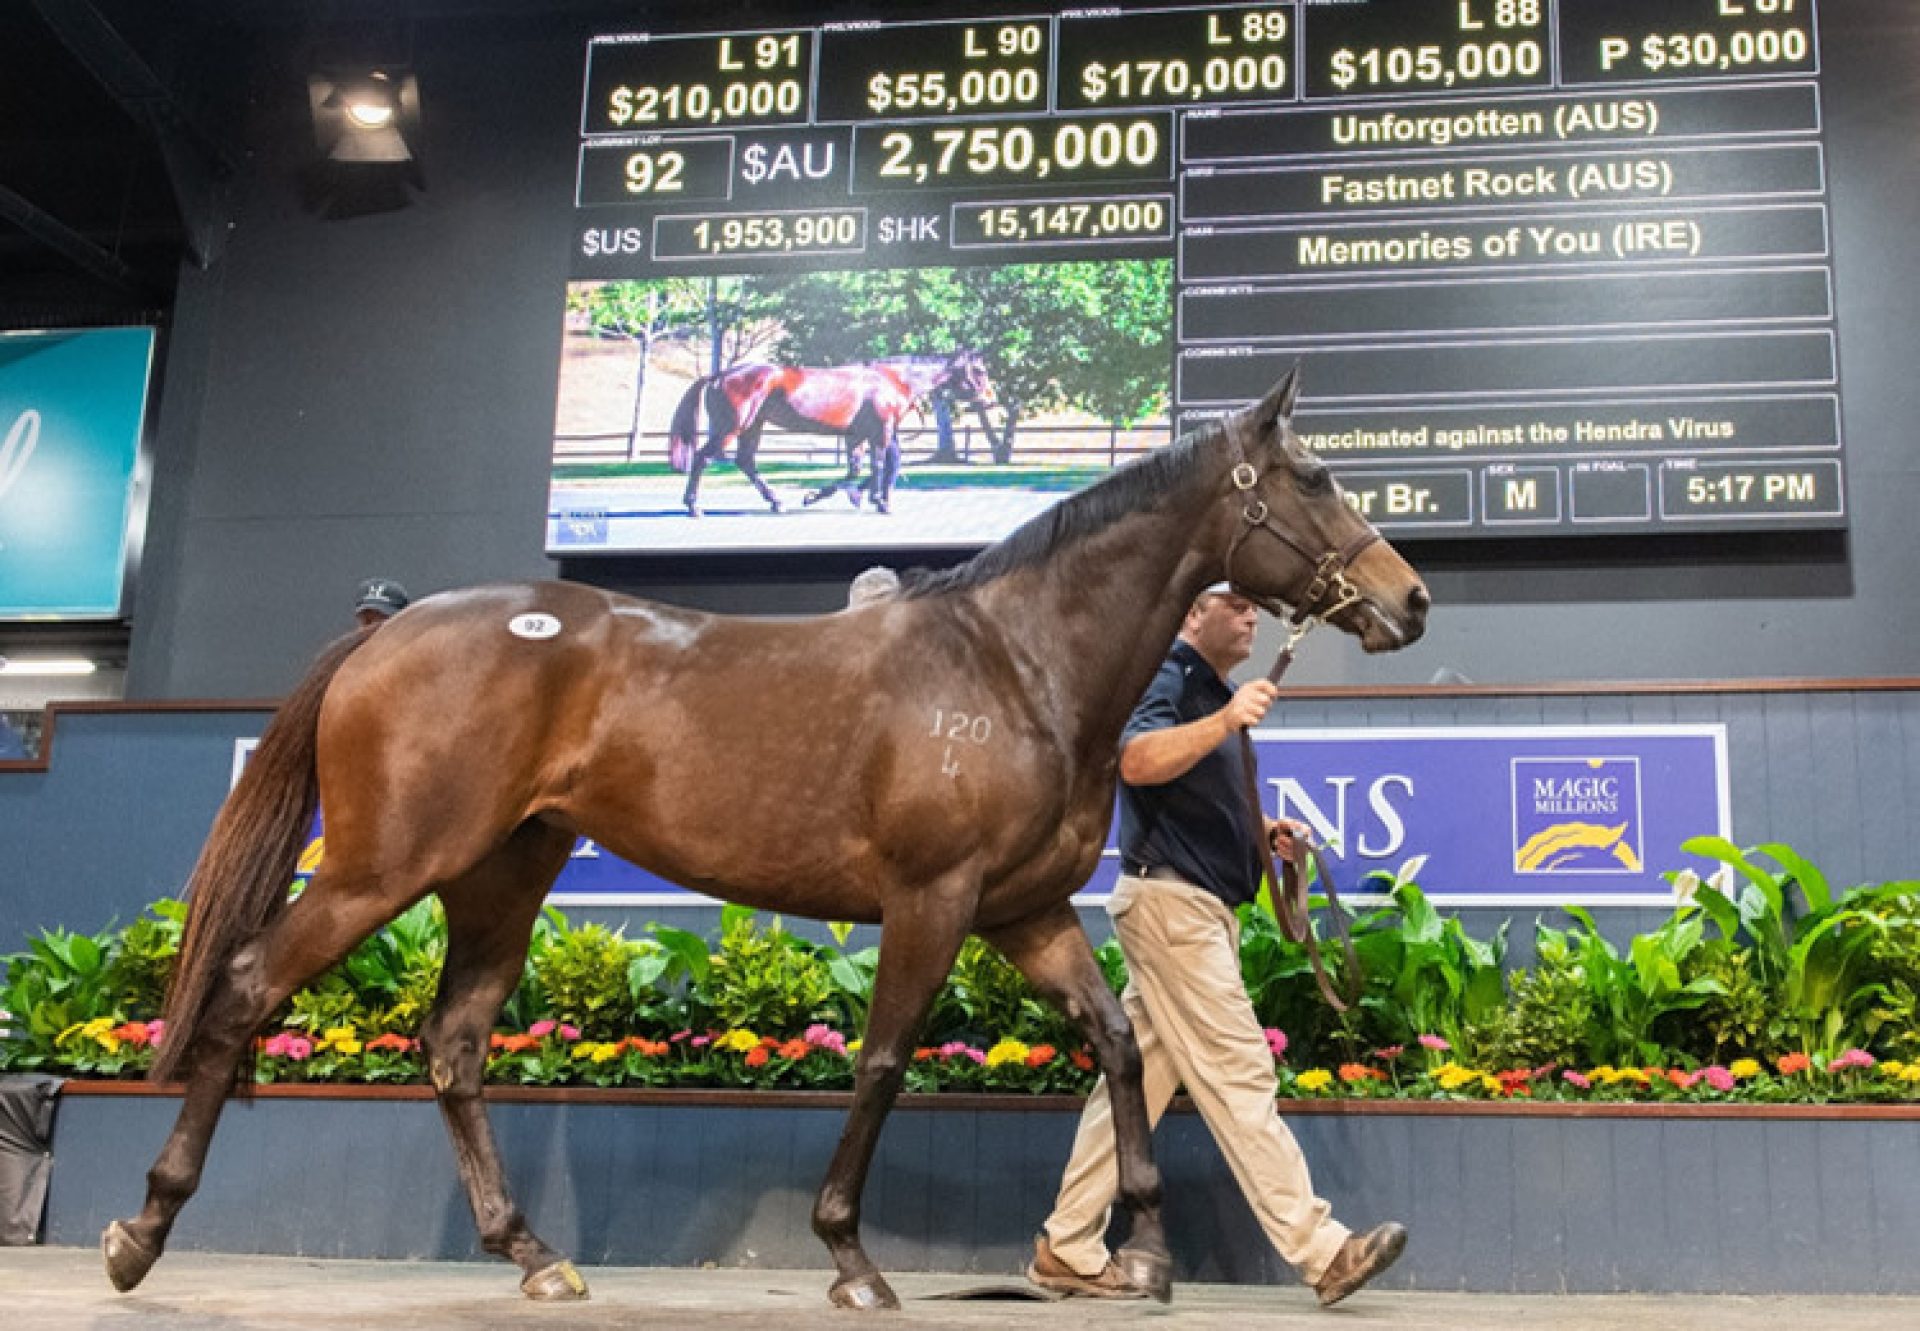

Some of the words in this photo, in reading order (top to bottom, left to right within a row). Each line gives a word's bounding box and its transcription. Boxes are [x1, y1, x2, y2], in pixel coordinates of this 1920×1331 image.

[1208, 15, 1232, 44] L
[1241, 12, 1286, 42] 89
[1459, 0, 1484, 30] L
[1494, 0, 1540, 28] 88
[718, 38, 744, 71] L
[755, 35, 800, 68] 91
[964, 28, 988, 57] L
[998, 25, 1042, 55] 90
[1600, 37, 1630, 71] P
[1641, 28, 1807, 72] $30,000
[1082, 54, 1286, 102] $170,000
[1330, 40, 1541, 90] $105,000
[608, 79, 801, 126] $210,000
[867, 68, 1040, 113] $55,000
[1331, 109, 1544, 145] Unforgotten
[1553, 99, 1659, 138] (AUS)
[624, 151, 685, 193] 92
[741, 142, 835, 185] $AU
[879, 120, 1158, 184] 2,750,000
[1321, 171, 1455, 204] Fastnet
[1464, 165, 1557, 197] Rock
[1567, 160, 1673, 198] (AUS)
[693, 215, 857, 255] 1,953,900
[877, 214, 941, 244] $HK
[978, 201, 1164, 241] 15,147,000
[582, 228, 642, 257] $US
[1298, 231, 1473, 266] Memories
[1482, 227, 1521, 257] of
[1528, 225, 1601, 255] You
[1612, 219, 1702, 258] (IRE)
[1435, 421, 1523, 450] against
[1528, 421, 1569, 444] the
[1574, 417, 1664, 442] Hendra
[1668, 415, 1735, 439] Virus
[1386, 483, 1440, 514] Br.
[1505, 478, 1537, 511] M
[1687, 474, 1754, 504] 5:17
[1763, 472, 1816, 502] PM
[928, 708, 992, 745] 120
[1533, 777, 1619, 799] MAGIC
[1535, 800, 1619, 814] MILLIONS
[1267, 774, 1415, 860] NS
